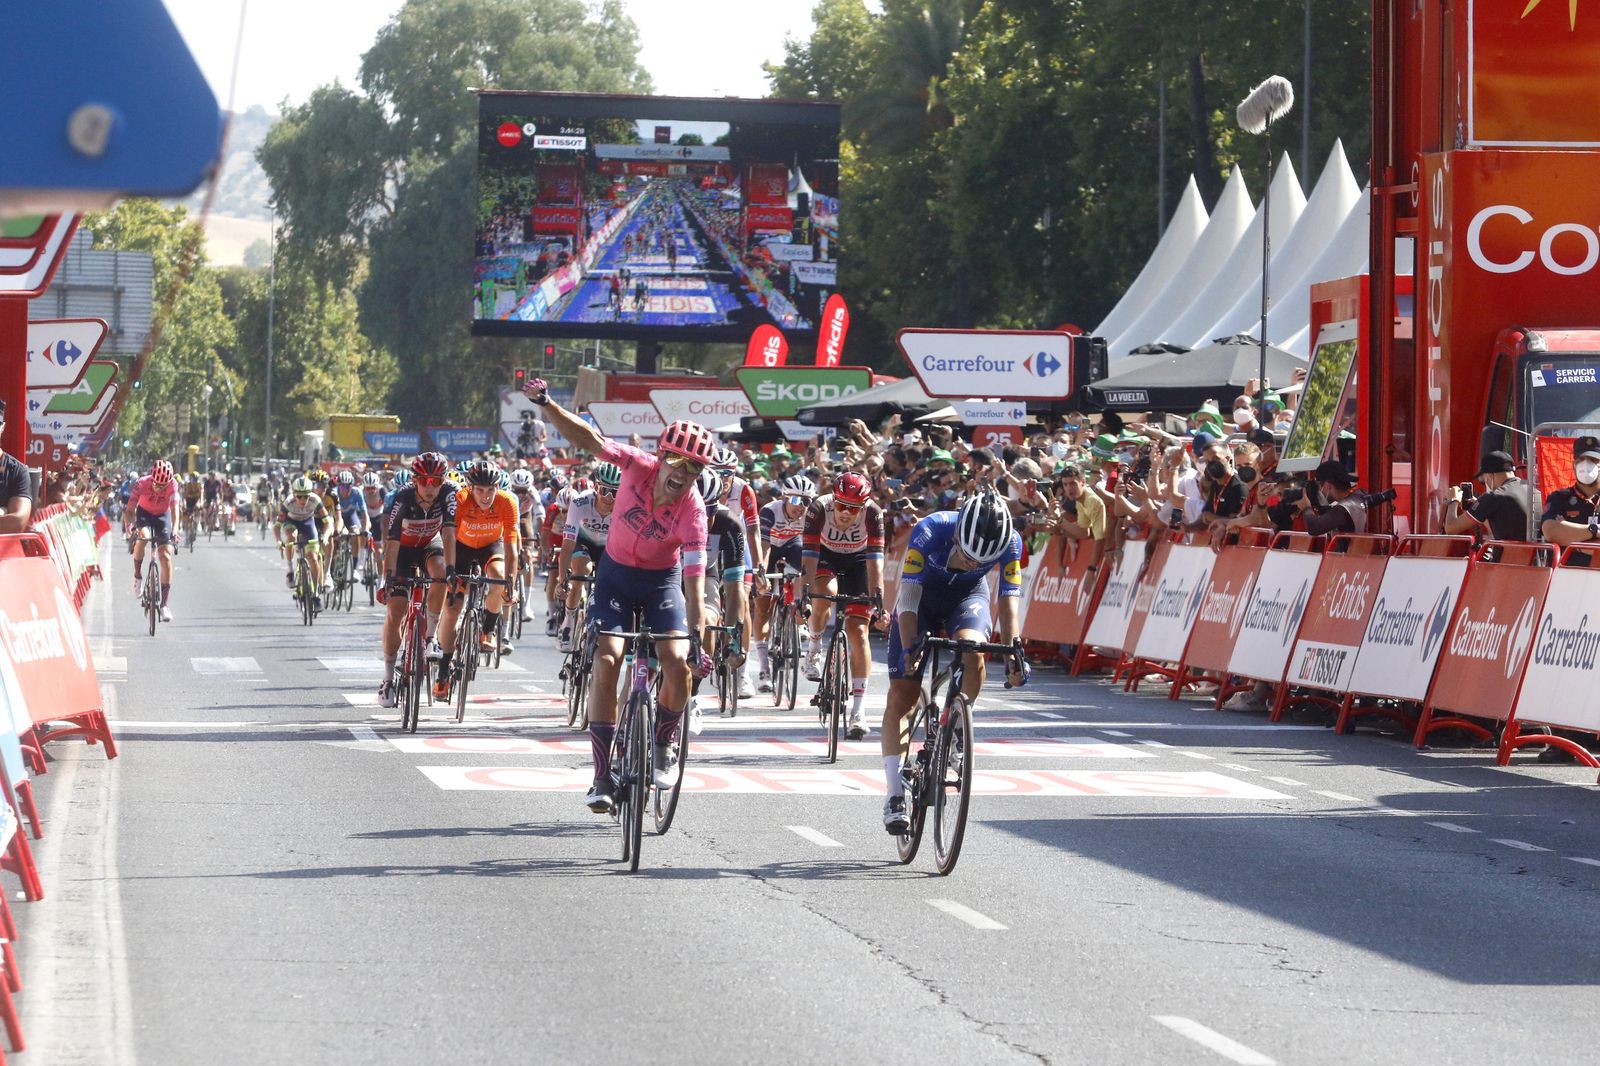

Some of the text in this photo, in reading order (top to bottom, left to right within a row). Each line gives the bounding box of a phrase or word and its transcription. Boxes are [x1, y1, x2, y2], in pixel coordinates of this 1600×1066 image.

[551, 139, 583, 147] TISSOT
[922, 355, 1015, 373] Carrefour
[1556, 368, 1596, 377] SERVICIO
[1556, 376, 1597, 384] CARRERA
[756, 380, 858, 401] ŠKODA
[1118, 392, 1146, 402] VUELTA
[688, 401, 751, 415] Cofidis
[964, 409, 1005, 419] Carrefour
[985, 431, 1011, 448] 25
[828, 527, 861, 542] UAE
[1329, 570, 1370, 621] Cofidis
[1245, 586, 1288, 632] Carrefour
[1367, 596, 1424, 646] Carrefour
[1450, 606, 1508, 661] Carrefour
[1535, 612, 1600, 670] Carrefour
[1310, 648, 1347, 686] TISSOT
